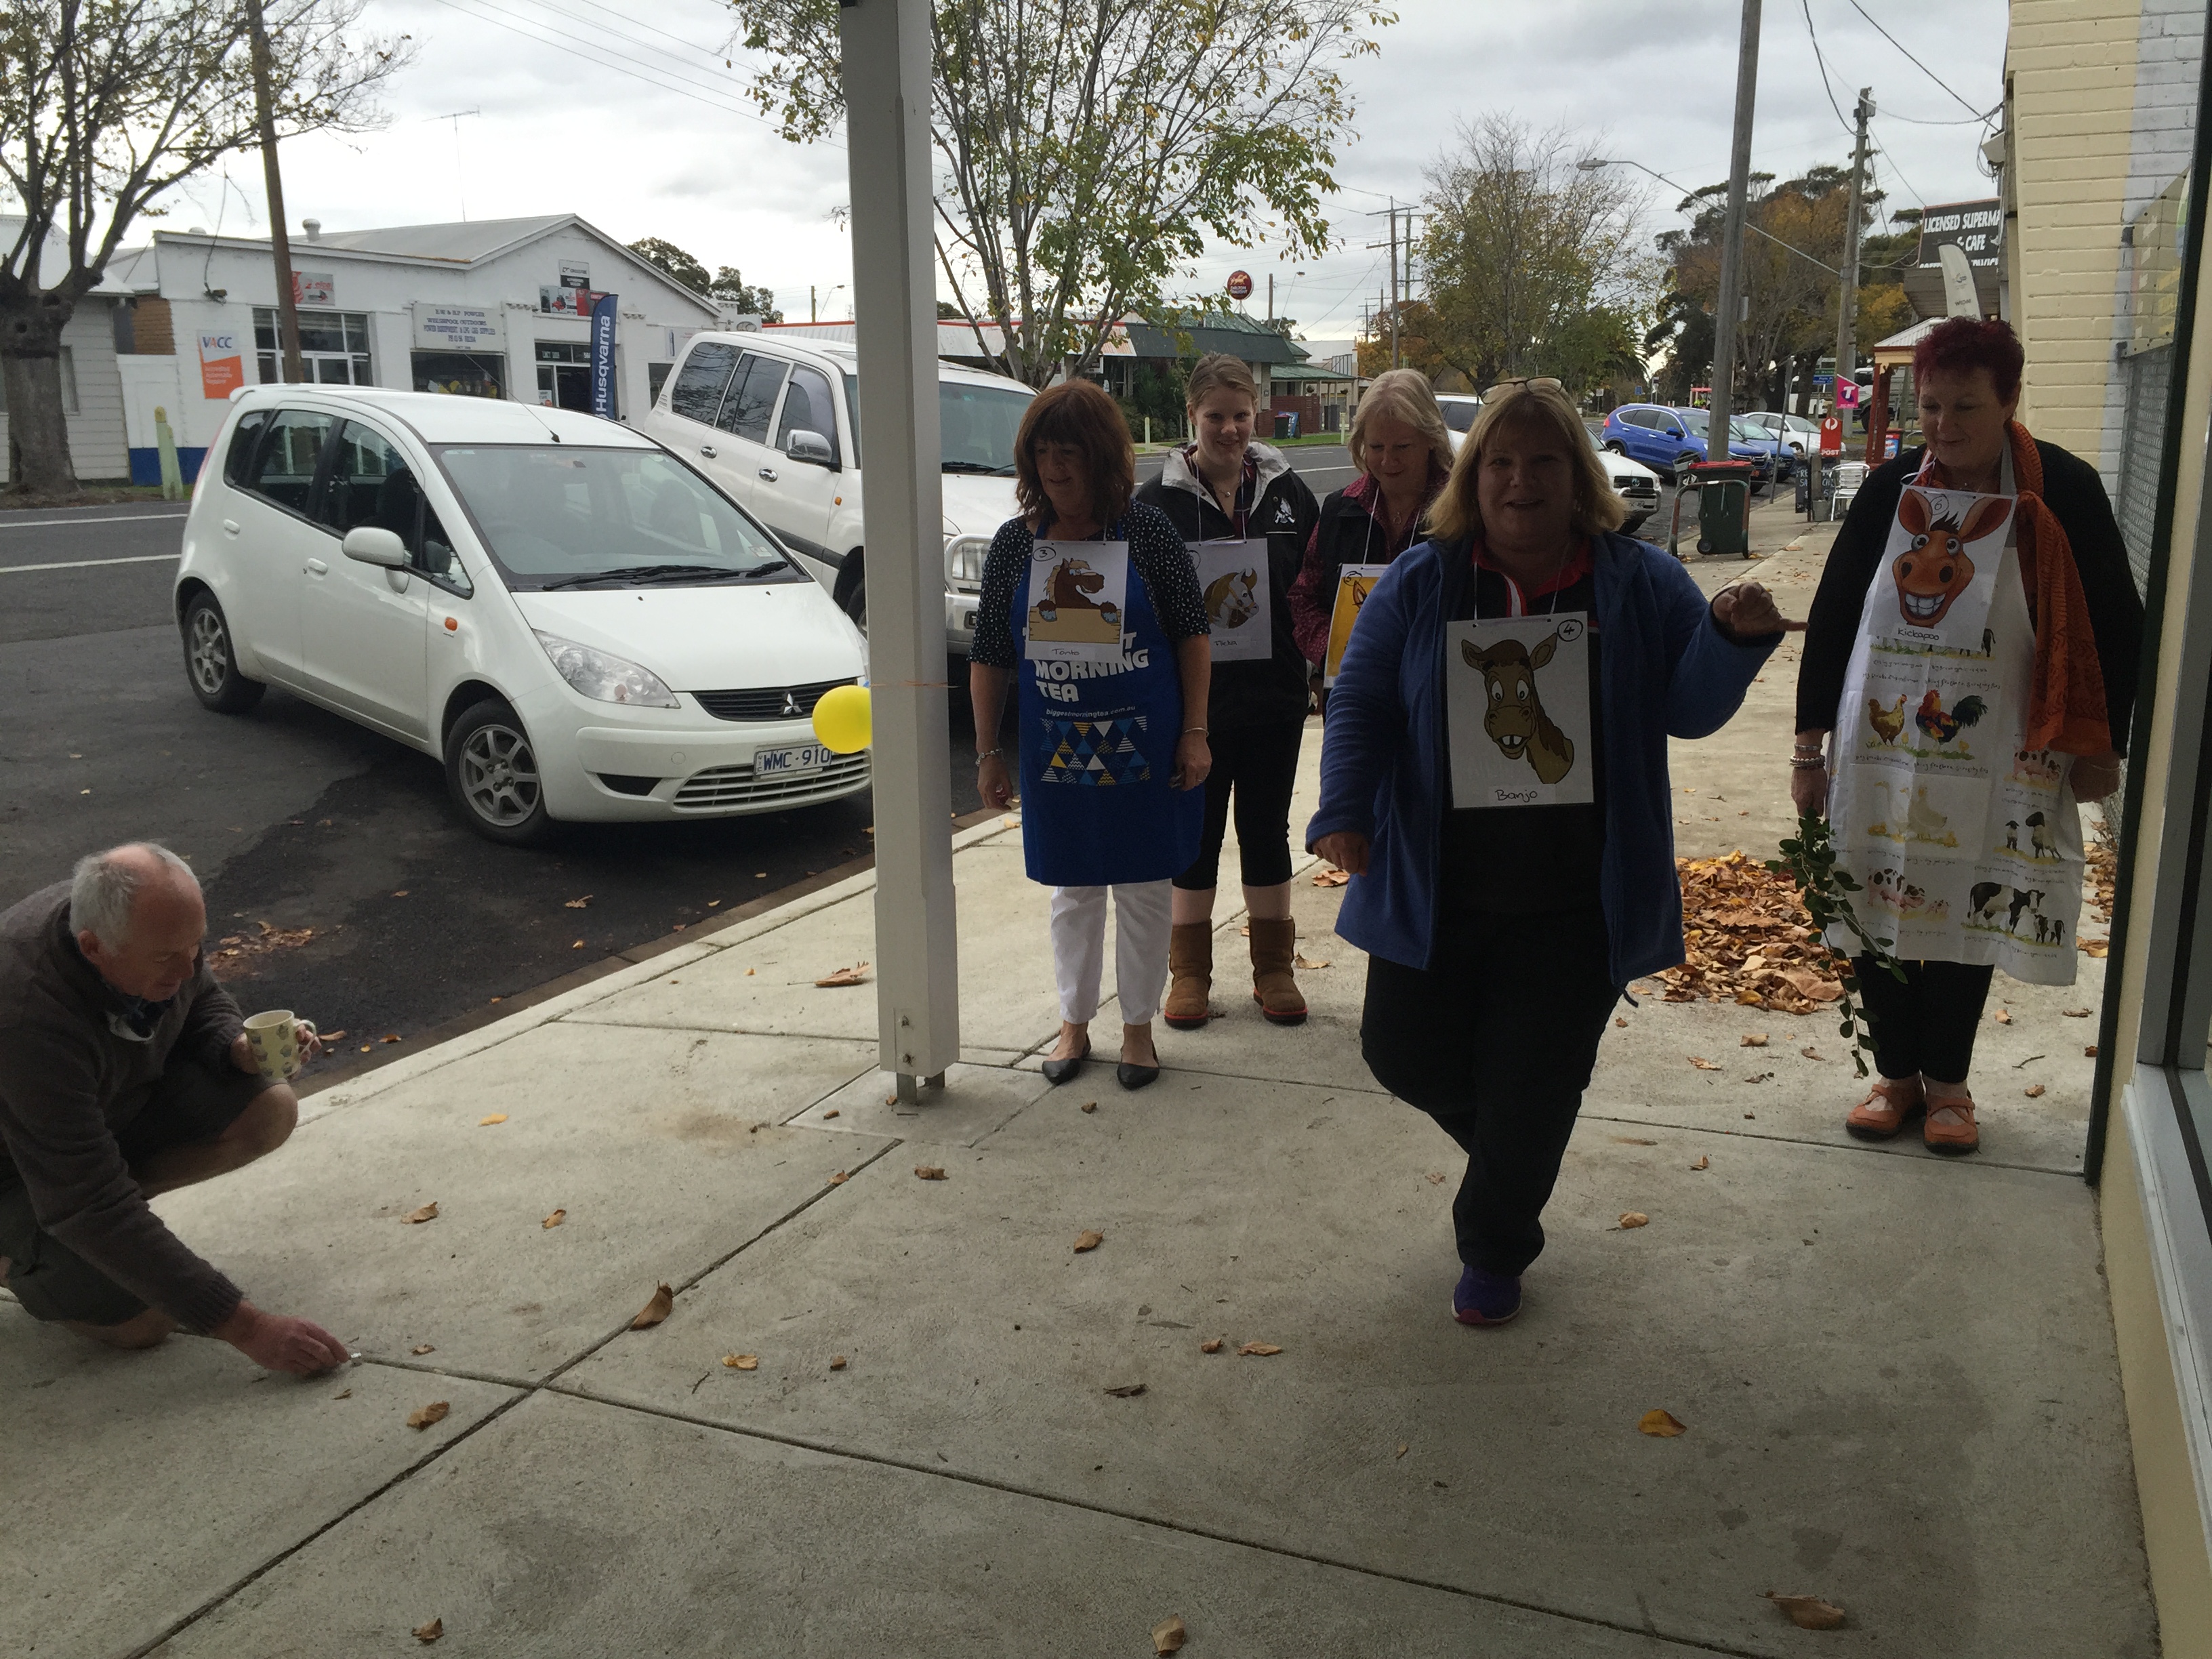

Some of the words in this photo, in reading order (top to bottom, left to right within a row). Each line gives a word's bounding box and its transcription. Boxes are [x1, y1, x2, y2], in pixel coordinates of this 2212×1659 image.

[1924, 214, 1961, 233] LICENSED
[1966, 234, 1986, 251] CAFE
[203, 336, 232, 348] VACC
[596, 315, 611, 412] Husqvarna
[1934, 499, 1942, 510] 6
[1039, 550, 1048, 558] 3
[1563, 623, 1575, 636] 4
[1052, 648, 1080, 656] Tonto
[1033, 649, 1149, 681] MORNING
[1036, 680, 1080, 703] TEA
[1046, 705, 1136, 718] biggestmorningtea.com.au
[1494, 789, 1538, 803] Banjo
